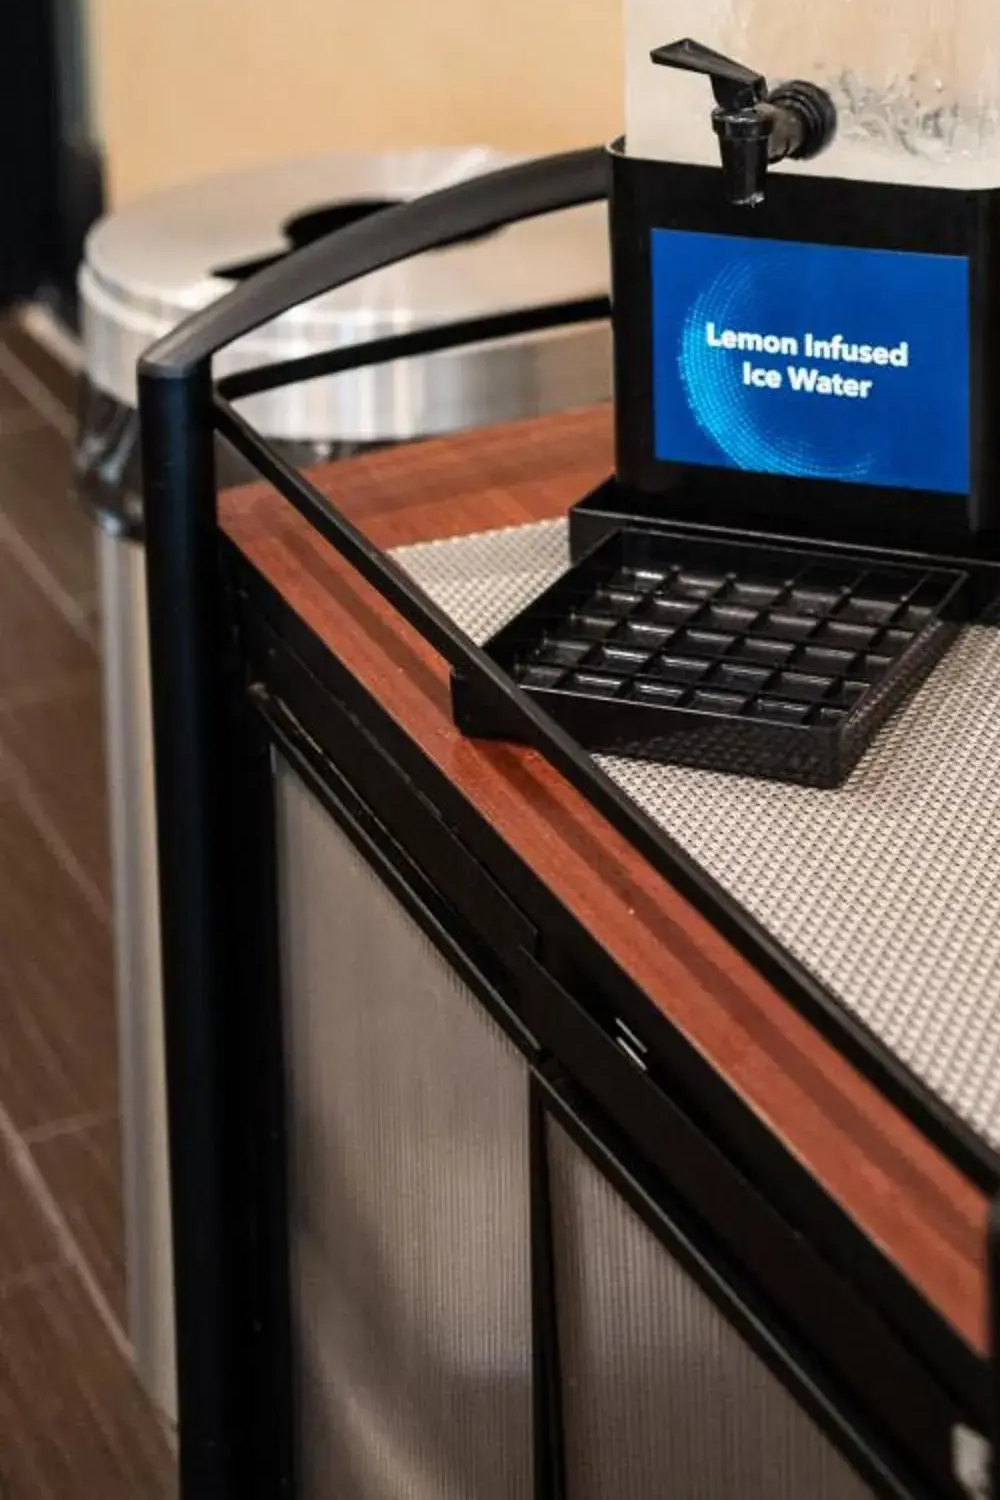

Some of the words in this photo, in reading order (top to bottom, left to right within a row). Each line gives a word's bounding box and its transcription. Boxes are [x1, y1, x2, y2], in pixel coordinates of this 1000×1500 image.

[706, 322, 798, 355] Lemon
[806, 333, 908, 367] Infused
[743, 361, 782, 388] Ice
[787, 366, 873, 398] Water
